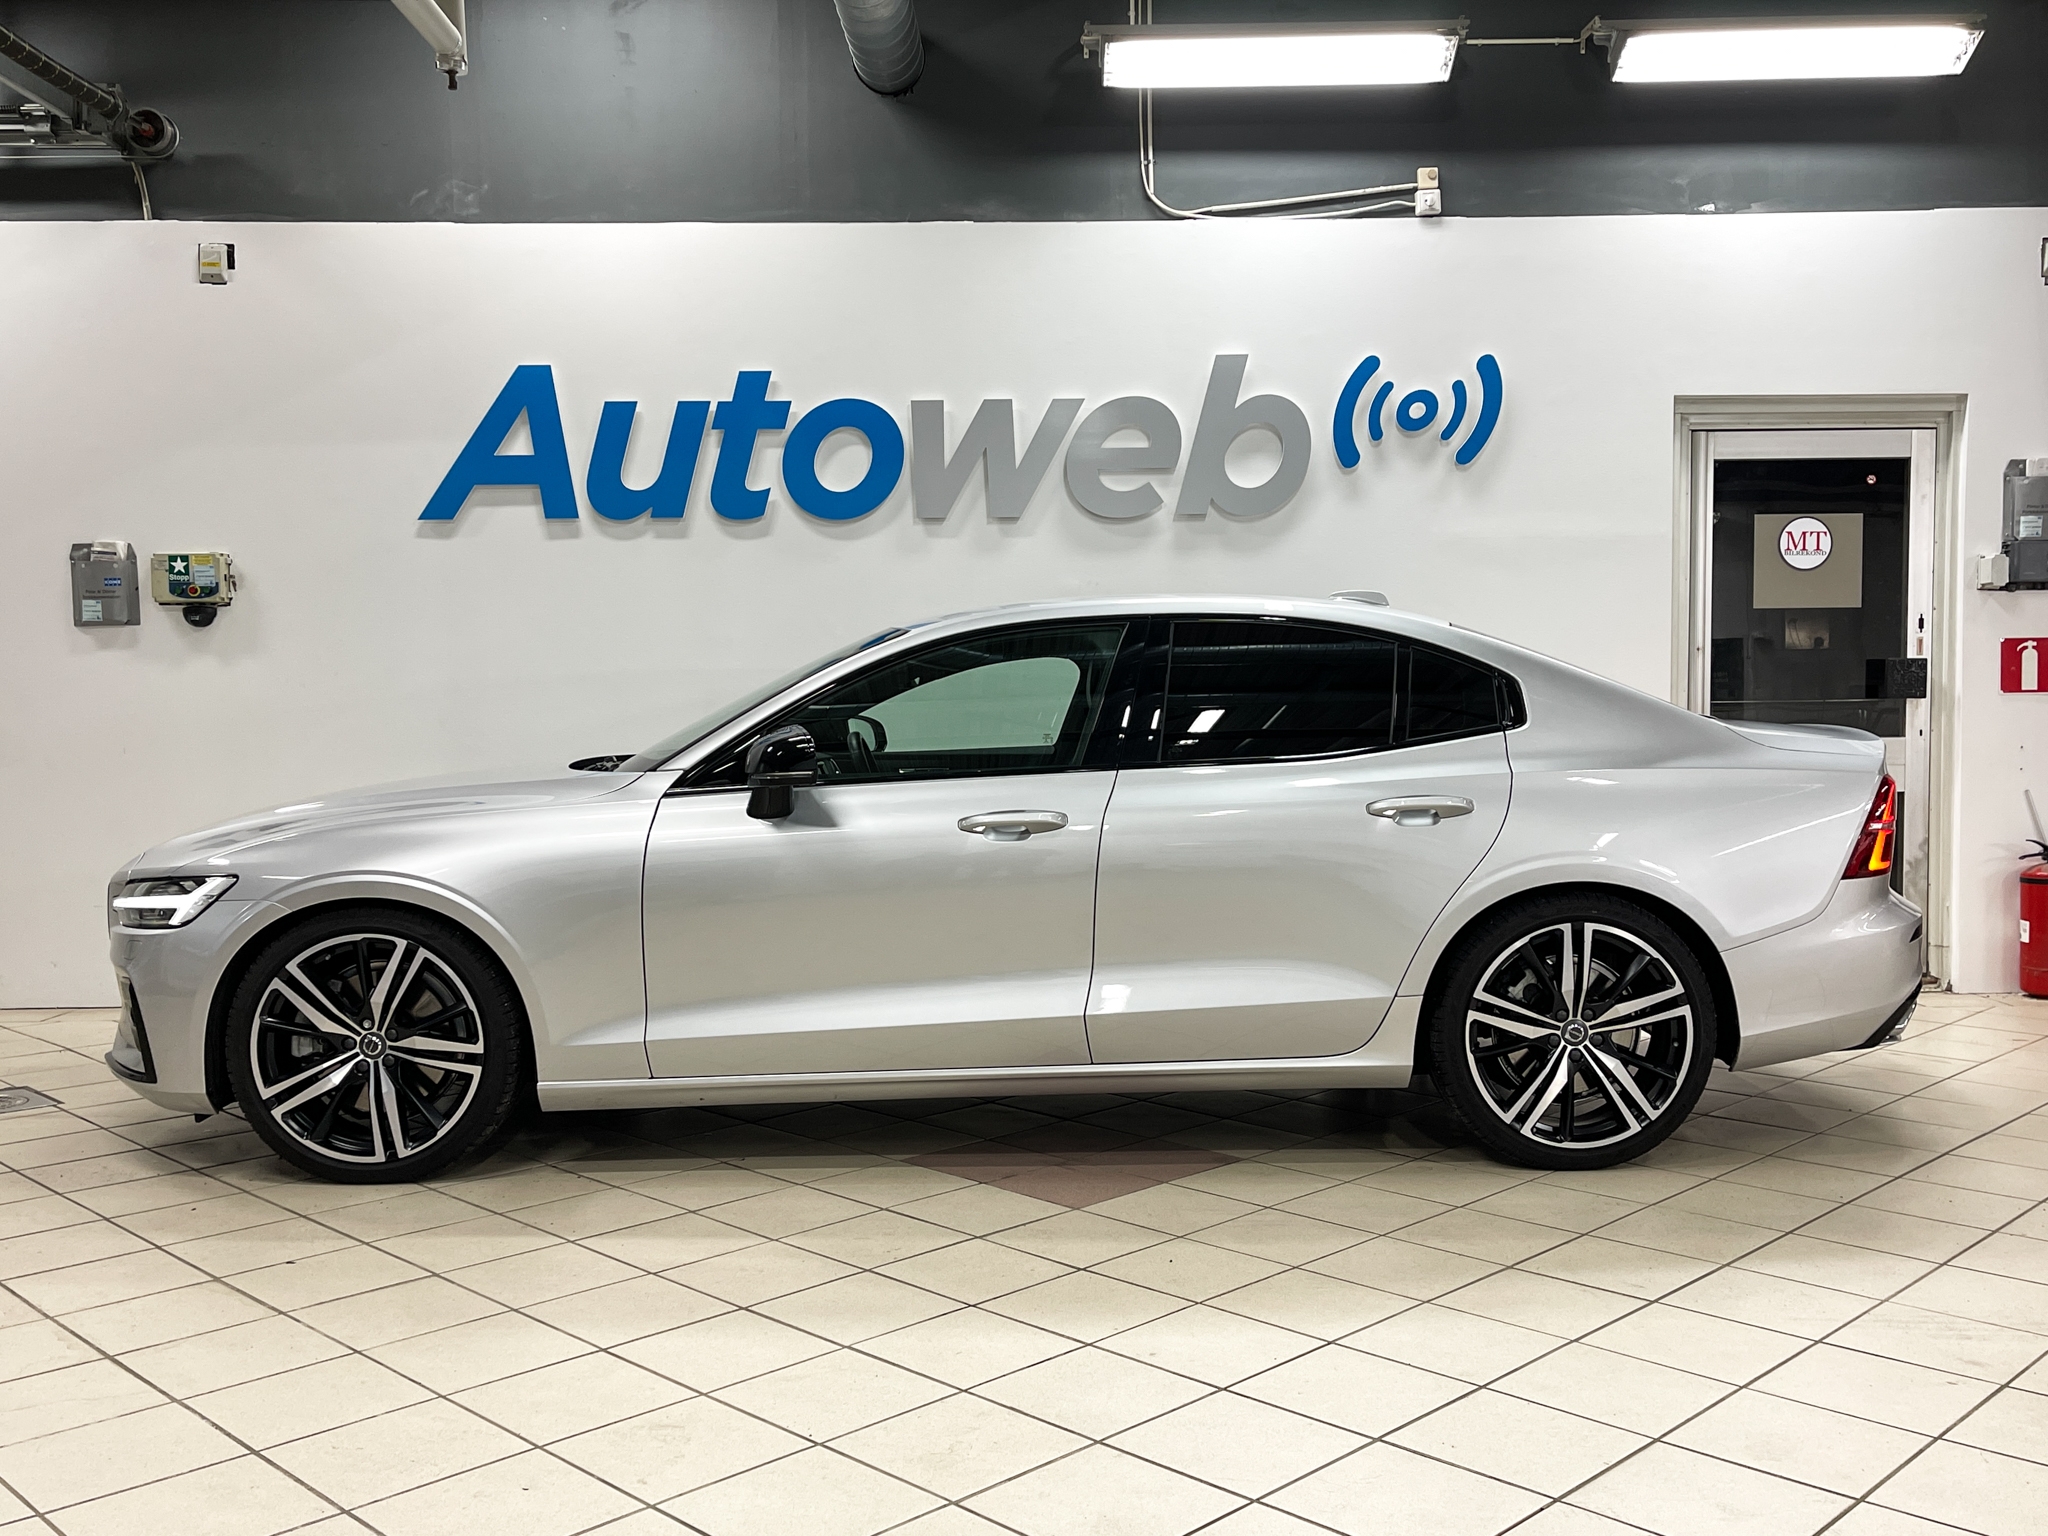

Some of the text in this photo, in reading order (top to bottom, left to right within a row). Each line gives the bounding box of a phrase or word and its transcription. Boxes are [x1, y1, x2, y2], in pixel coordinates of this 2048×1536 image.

[416, 353, 1312, 521] Autoweb
[1785, 531, 1827, 551] MT
[169, 573, 190, 581] Stopp
